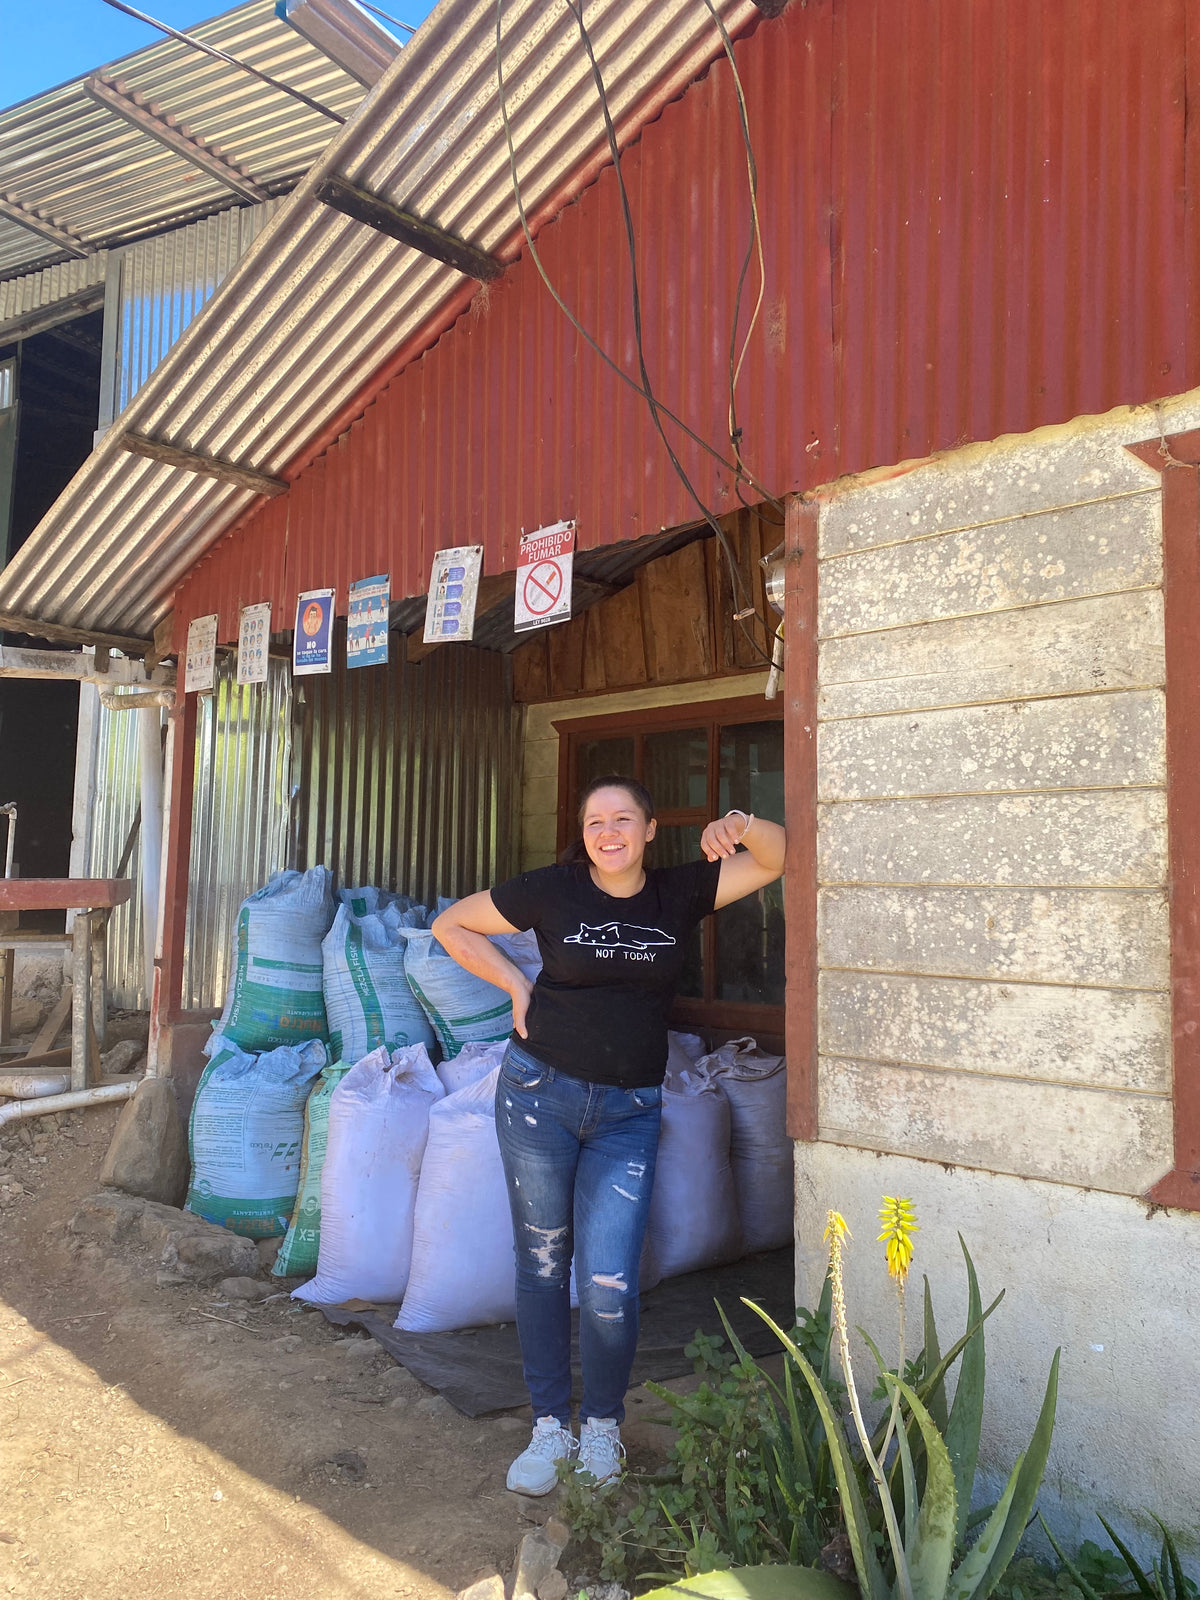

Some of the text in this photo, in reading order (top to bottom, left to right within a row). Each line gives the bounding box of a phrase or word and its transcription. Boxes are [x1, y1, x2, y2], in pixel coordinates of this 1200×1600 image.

[520, 531, 572, 555] PROHIBIDO
[528, 545, 561, 563] FUMAR
[306, 641, 316, 649] NO
[595, 948, 657, 962] NOT TODAY
[236, 964, 245, 998] MEZCLA
[356, 966, 370, 997] MEZCLA
